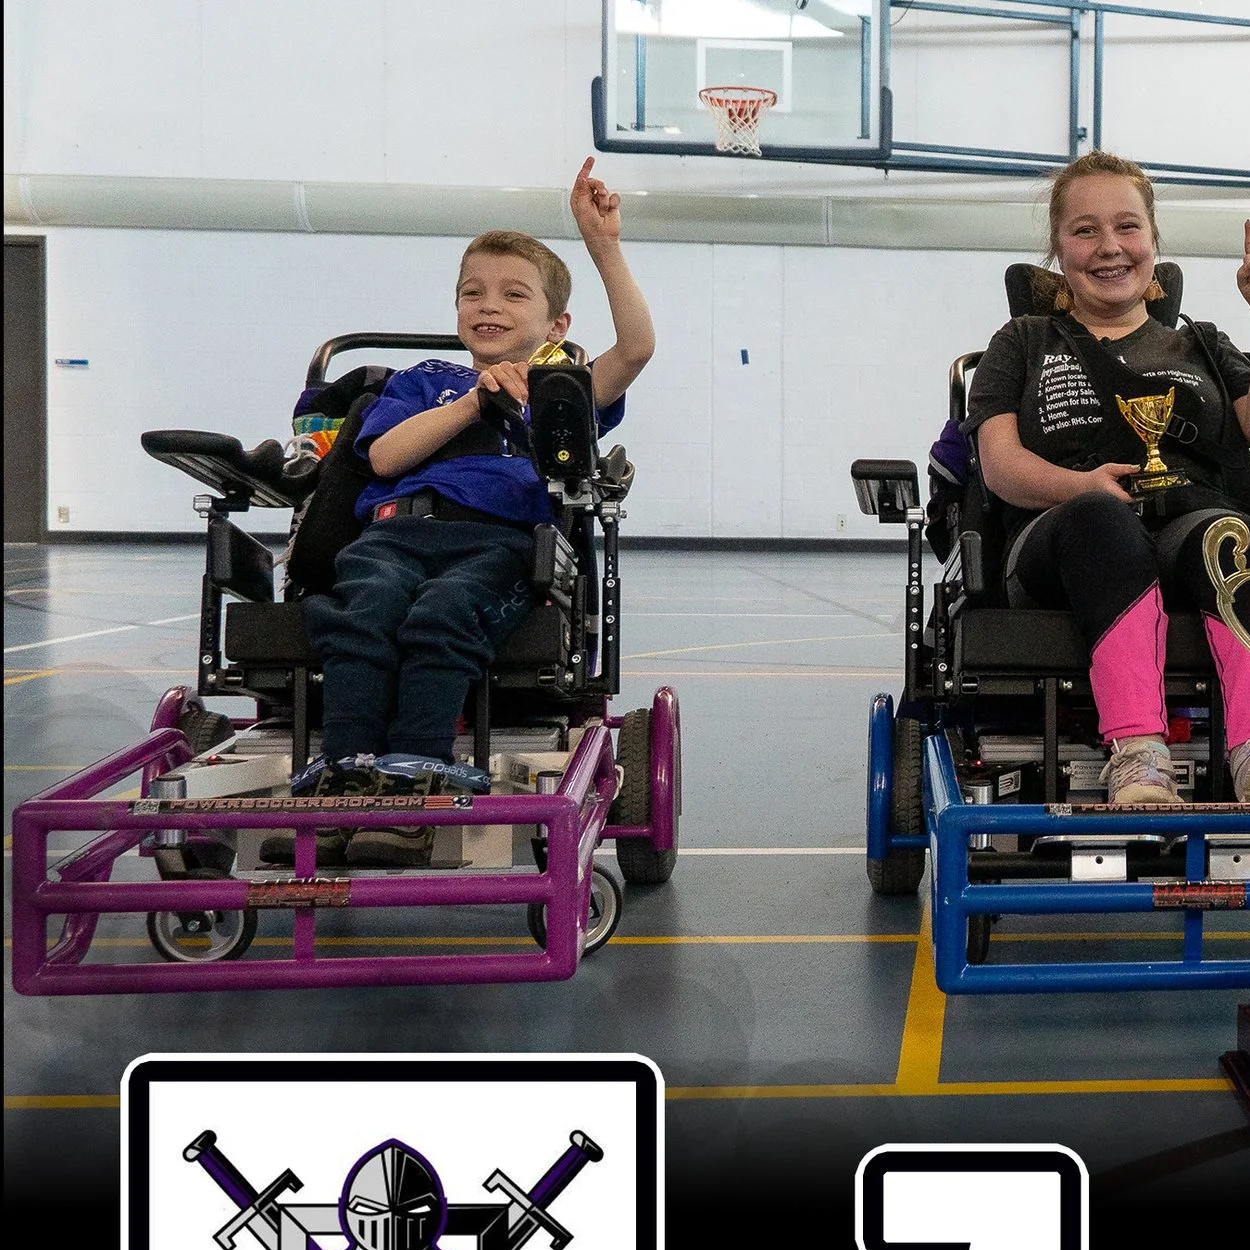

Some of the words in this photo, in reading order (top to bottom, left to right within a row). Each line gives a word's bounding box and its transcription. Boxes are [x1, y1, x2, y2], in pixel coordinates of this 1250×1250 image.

[1042, 354, 1078, 367] Ray
[1050, 375, 1067, 383] town
[1045, 383, 1067, 393] Known
[1045, 389, 1079, 402] Latter-day
[1080, 388, 1096, 396] Sain
[1046, 400, 1069, 412] Known
[1069, 398, 1080, 406] for
[1047, 410, 1069, 422] Home.
[1042, 424, 1056, 435] (see
[1055, 420, 1071, 430] also:
